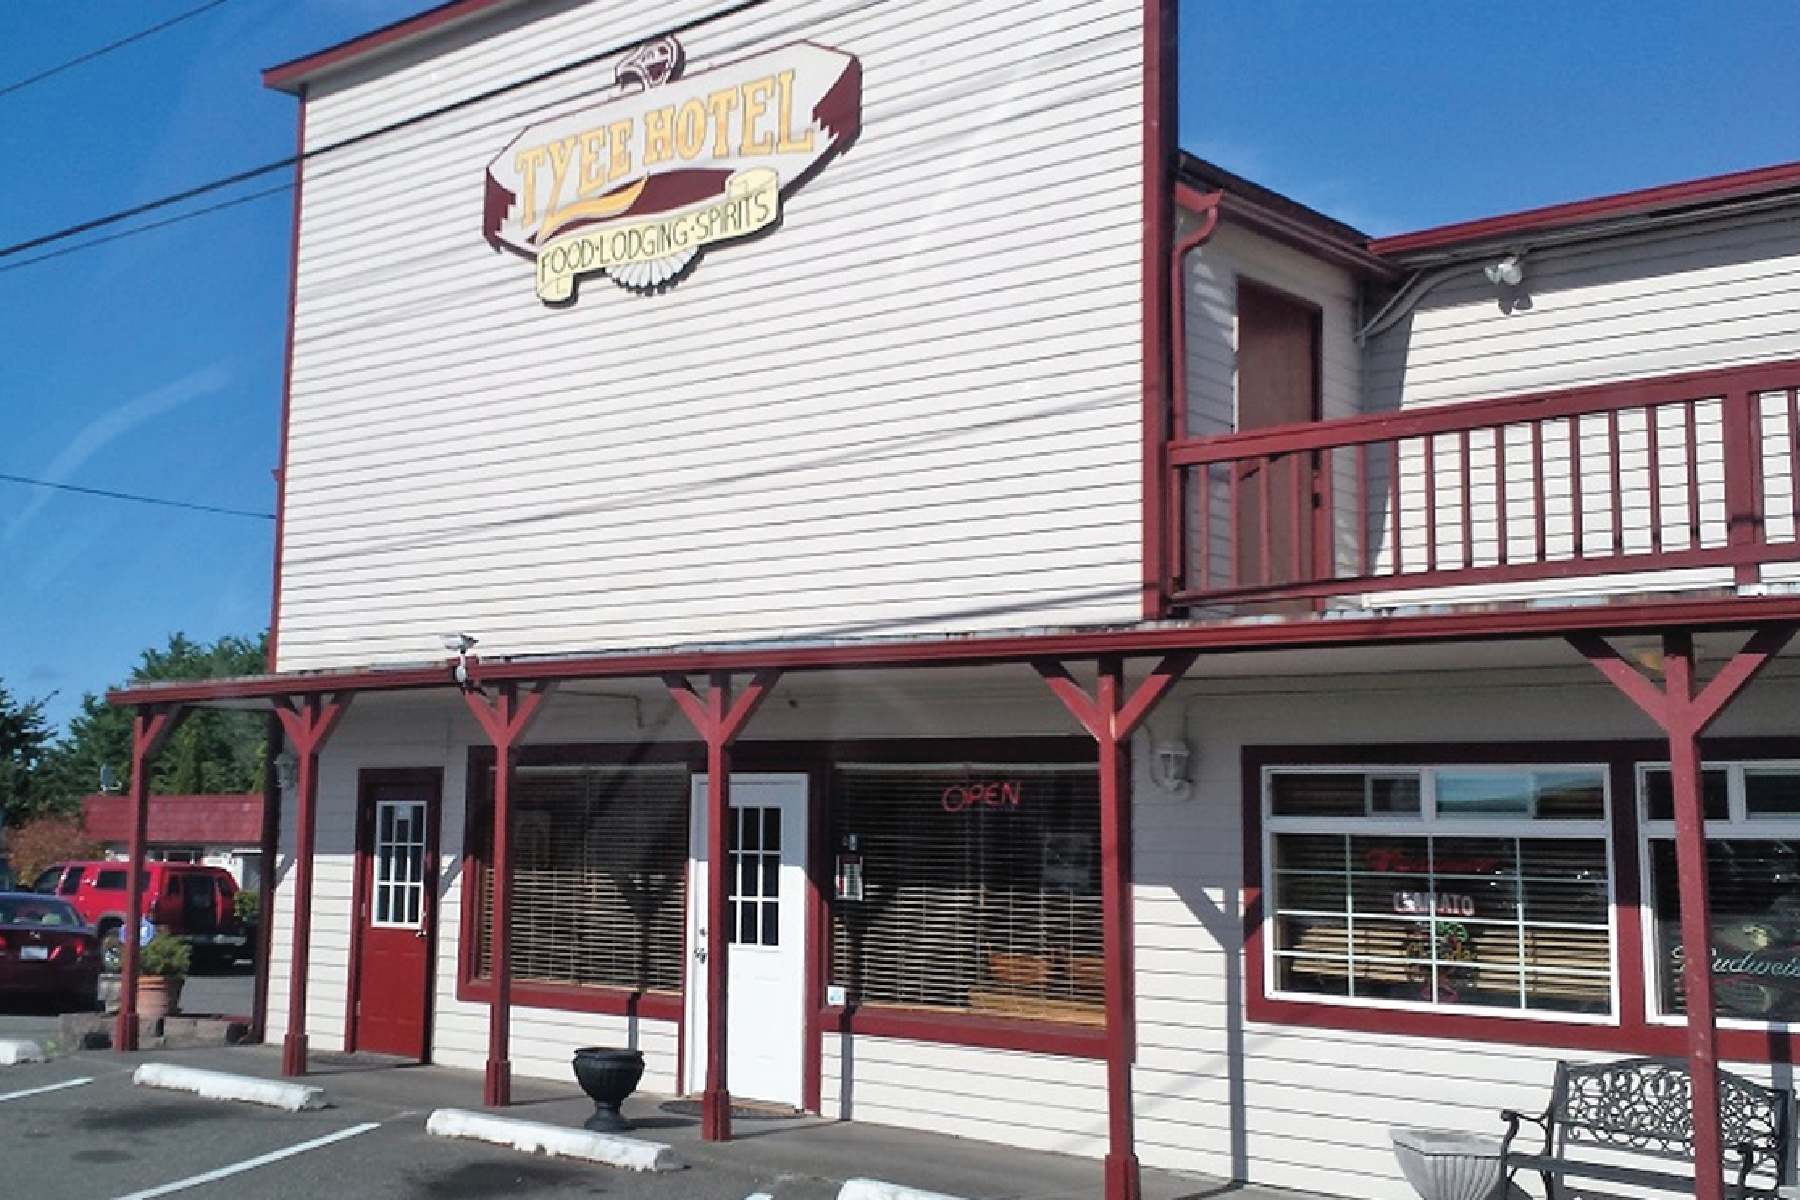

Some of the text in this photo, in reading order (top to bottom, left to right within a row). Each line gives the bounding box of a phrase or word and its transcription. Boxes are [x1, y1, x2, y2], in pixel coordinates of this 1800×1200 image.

[514, 69, 815, 236] TYEE HOTEL
[942, 782, 1020, 812] OPEN
